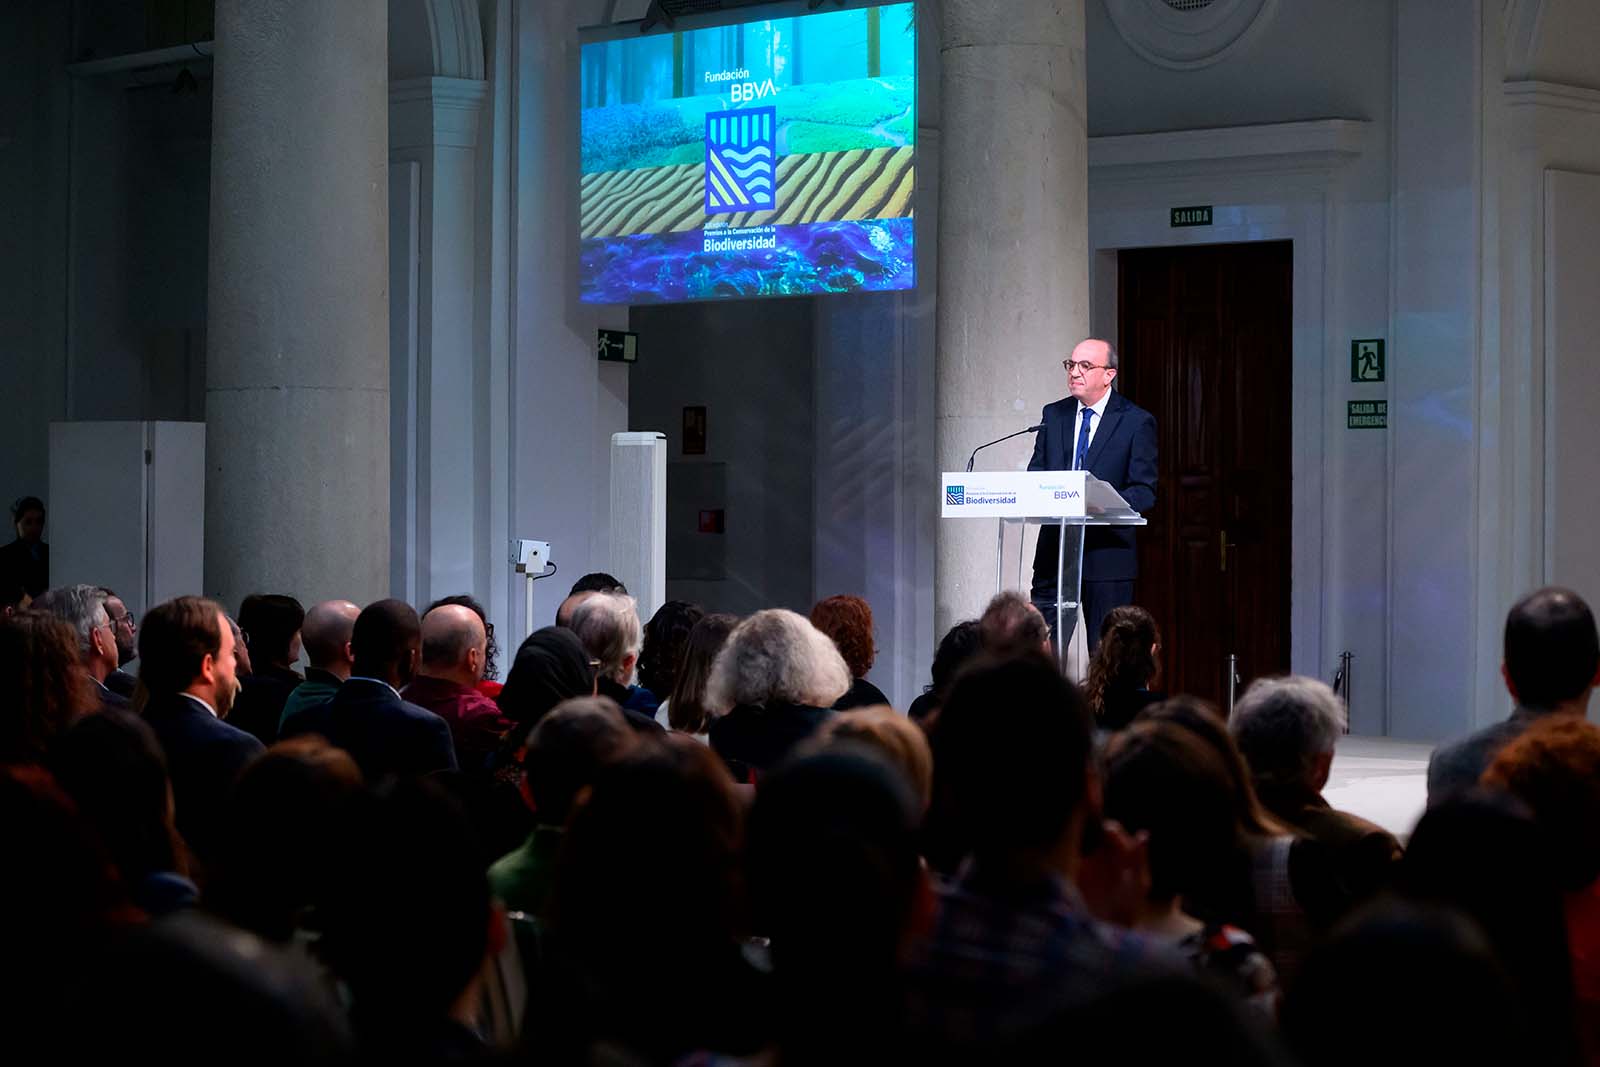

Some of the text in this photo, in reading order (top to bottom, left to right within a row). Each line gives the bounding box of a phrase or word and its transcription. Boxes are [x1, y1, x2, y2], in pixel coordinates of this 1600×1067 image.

[704, 68, 750, 83] Fundación
[731, 77, 777, 103] BBVA
[1174, 210, 1209, 223] SALIDA
[704, 235, 776, 252] Biodiversidad
[1352, 403, 1376, 414] SALIDA
[1350, 415, 1387, 426] EMERGENCI
[966, 496, 1017, 505] Biodiversidad
[1054, 490, 1080, 500] BBVA
